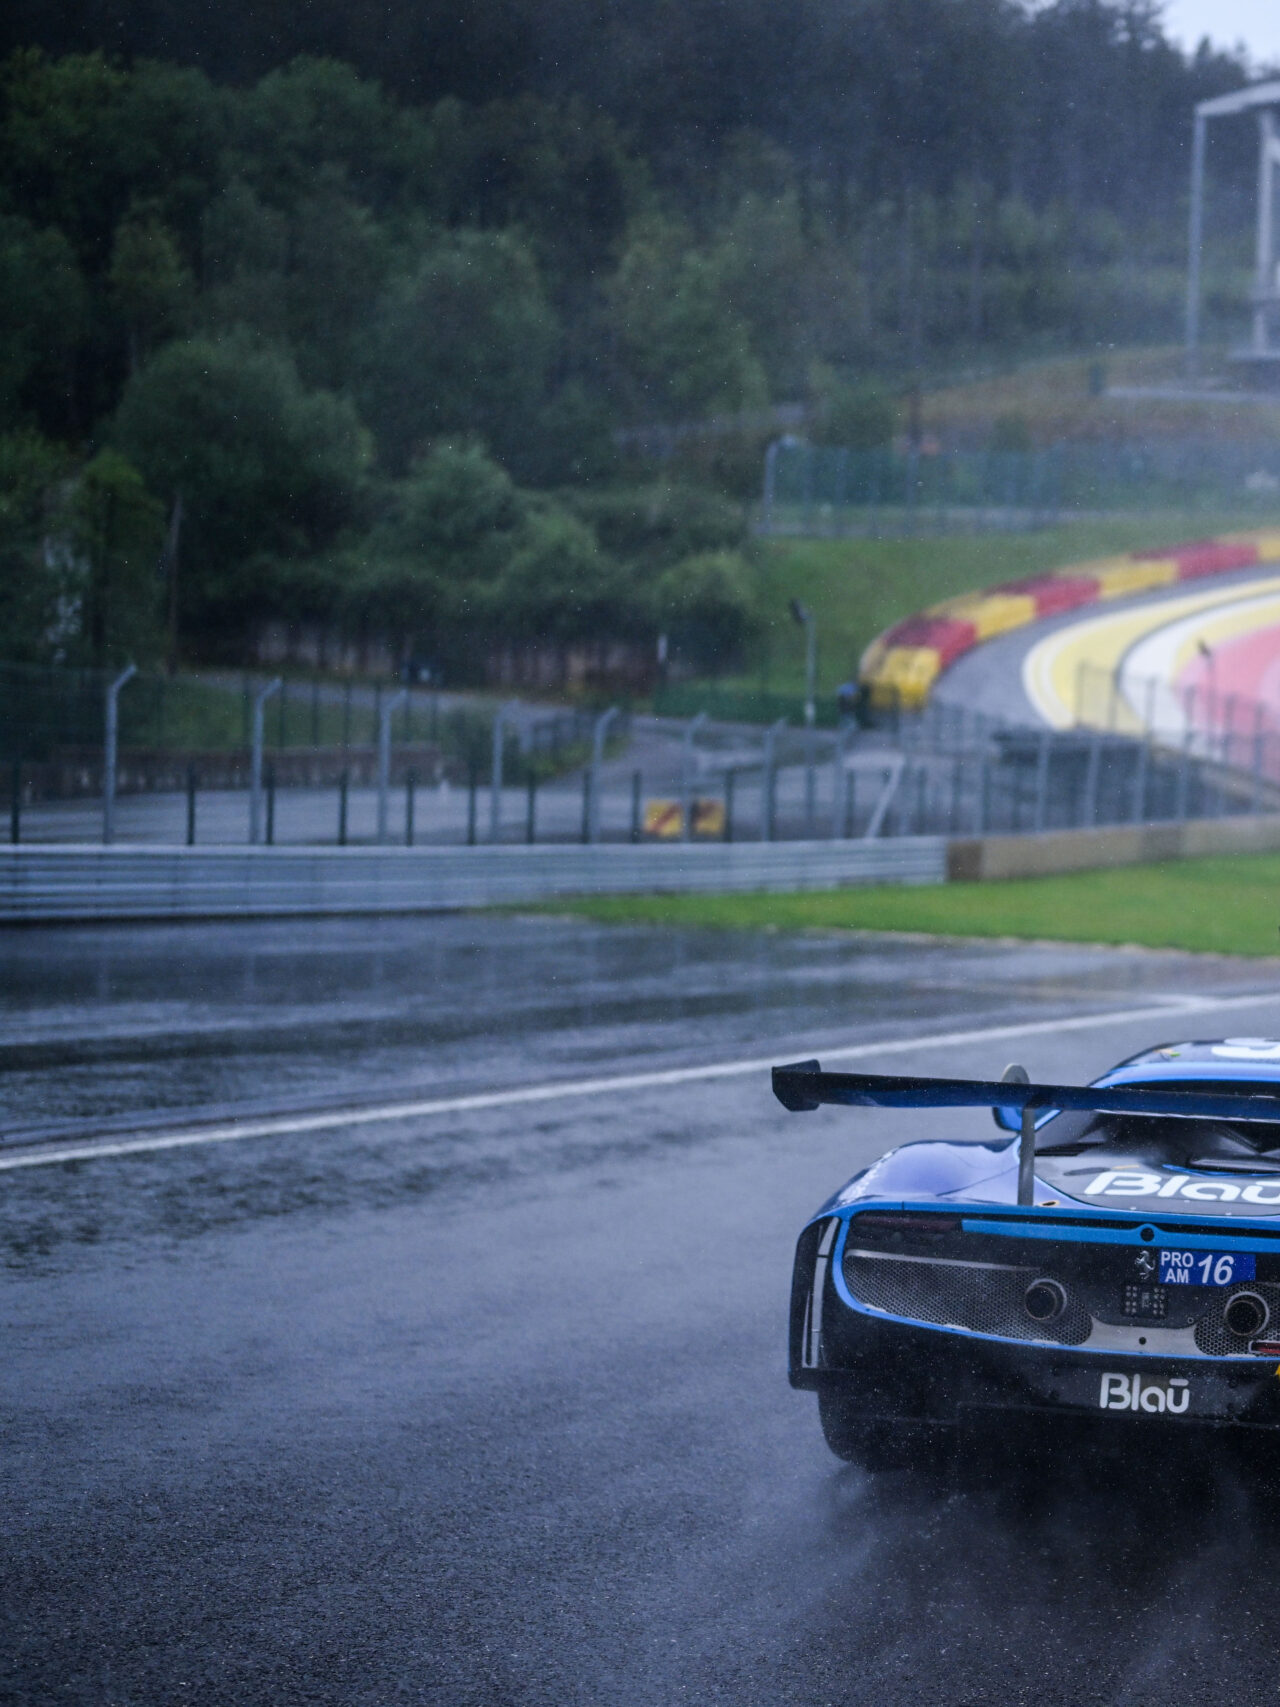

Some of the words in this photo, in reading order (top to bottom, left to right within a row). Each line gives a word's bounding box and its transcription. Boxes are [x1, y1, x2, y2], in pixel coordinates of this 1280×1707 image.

[1160, 1251, 1194, 1268] PRO
[1164, 1268, 1190, 1284] AM
[1197, 1254, 1235, 1285] 16
